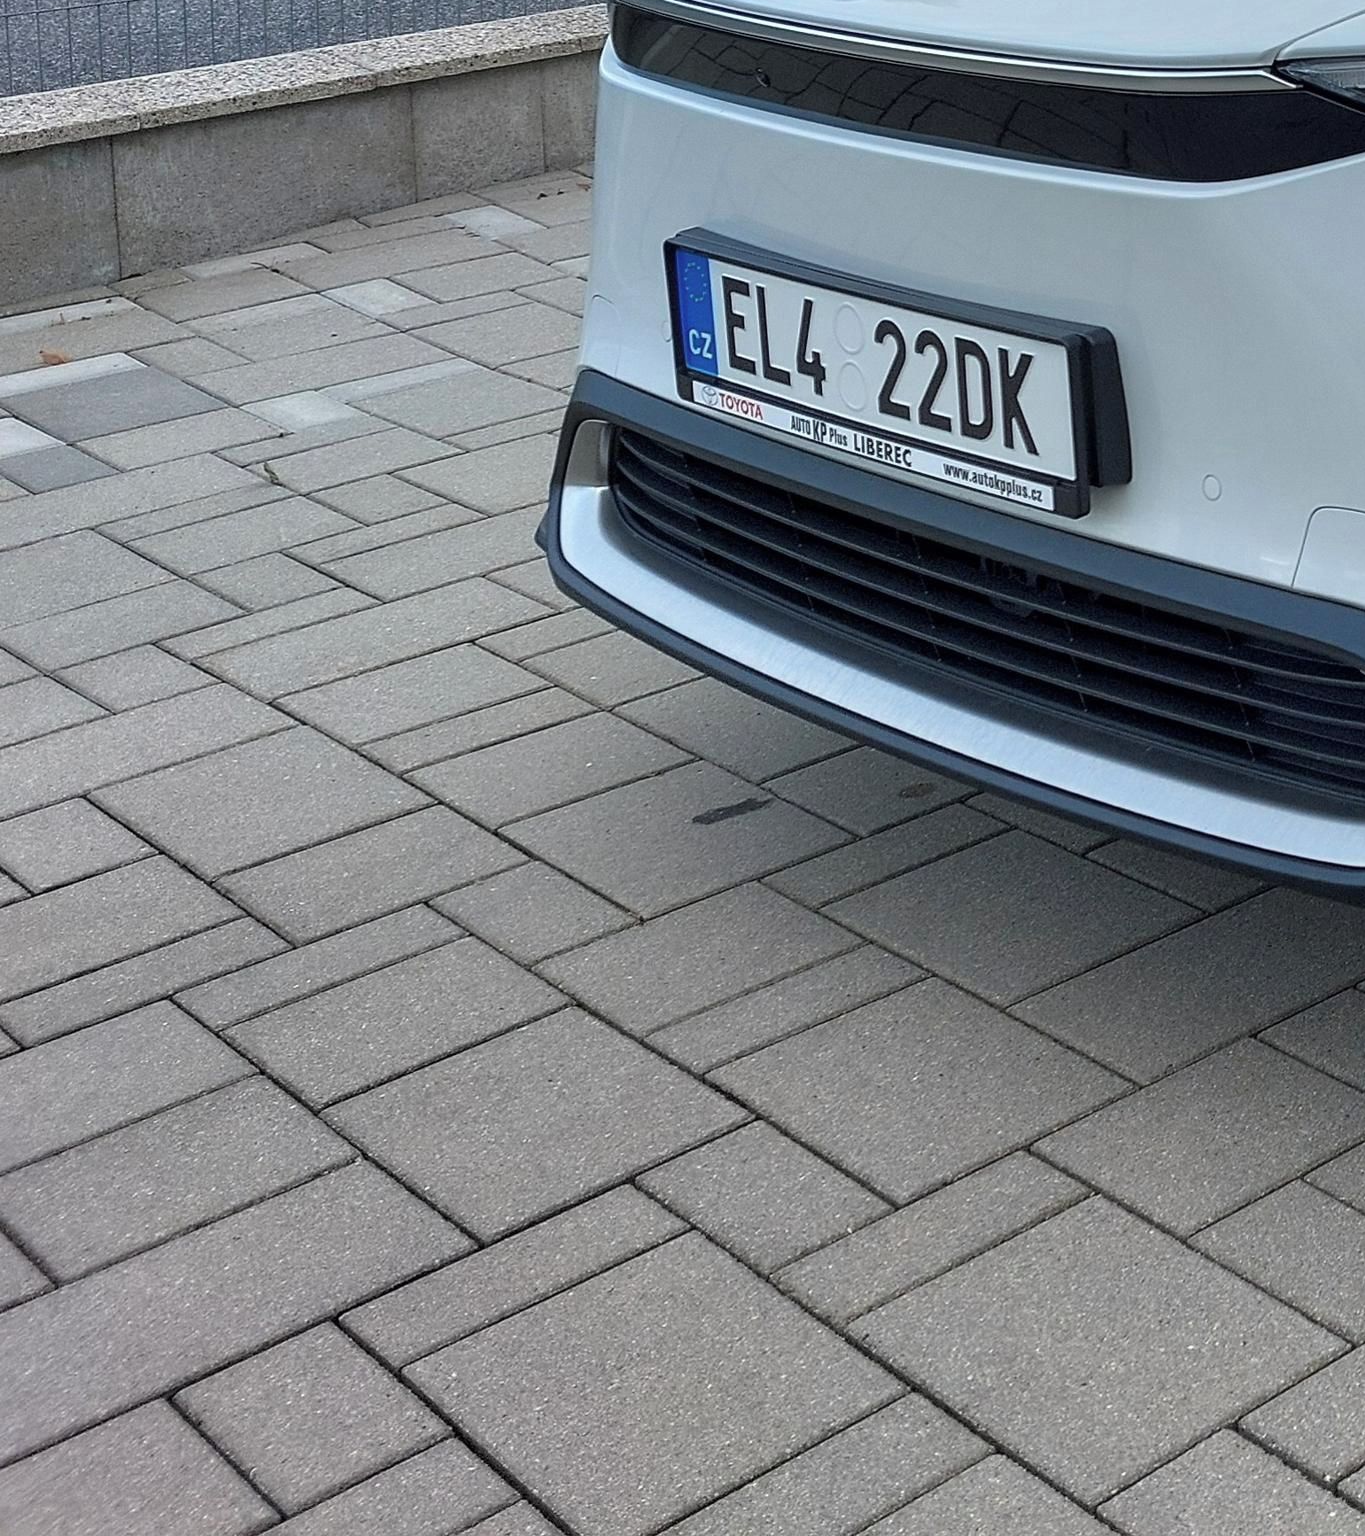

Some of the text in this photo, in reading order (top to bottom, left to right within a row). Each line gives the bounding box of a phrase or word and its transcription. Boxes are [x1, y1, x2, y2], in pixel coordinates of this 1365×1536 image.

[689, 328, 713, 360] CZ
[722, 275, 1040, 457] EL4 22DK
[719, 392, 763, 421] TOYOTA
[790, 415, 912, 468] AUTO KP Plus LIBEREC
[942, 462, 1043, 504] www.autokpplus.cz
